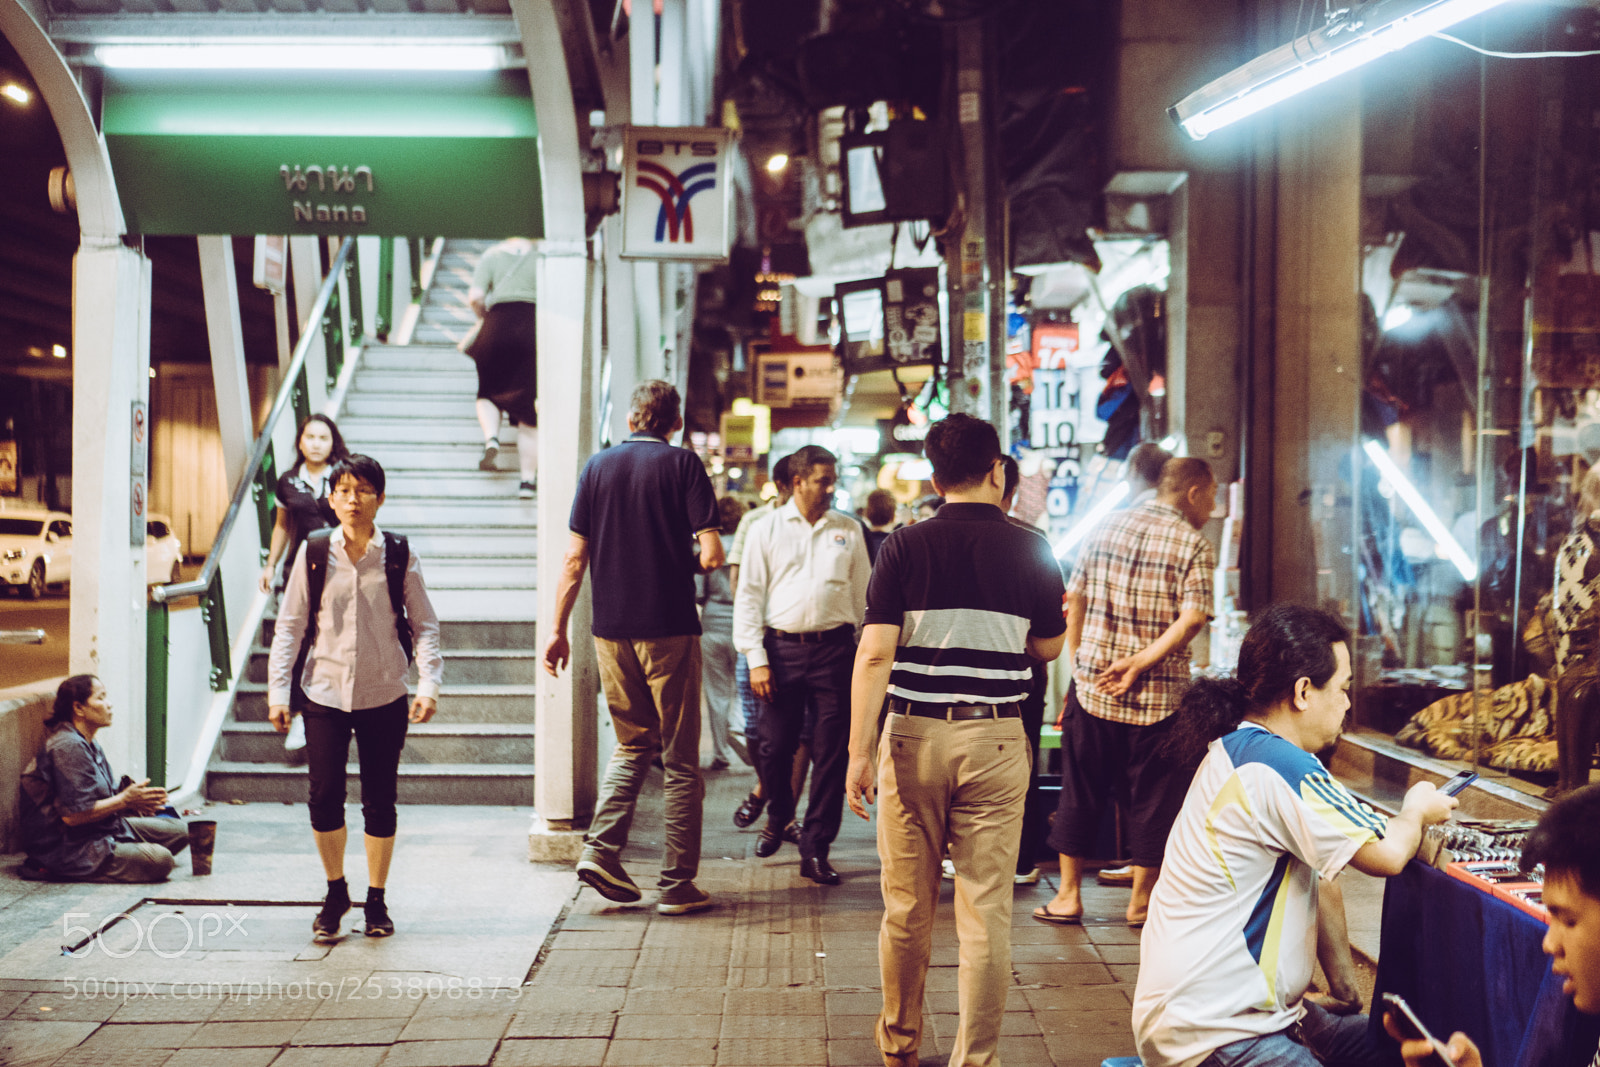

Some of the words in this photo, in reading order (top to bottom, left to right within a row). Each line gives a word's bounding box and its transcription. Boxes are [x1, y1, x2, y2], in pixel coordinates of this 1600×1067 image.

[637, 140, 717, 156] BTS
[279, 164, 374, 192] นานา
[292, 200, 367, 223] Nana
